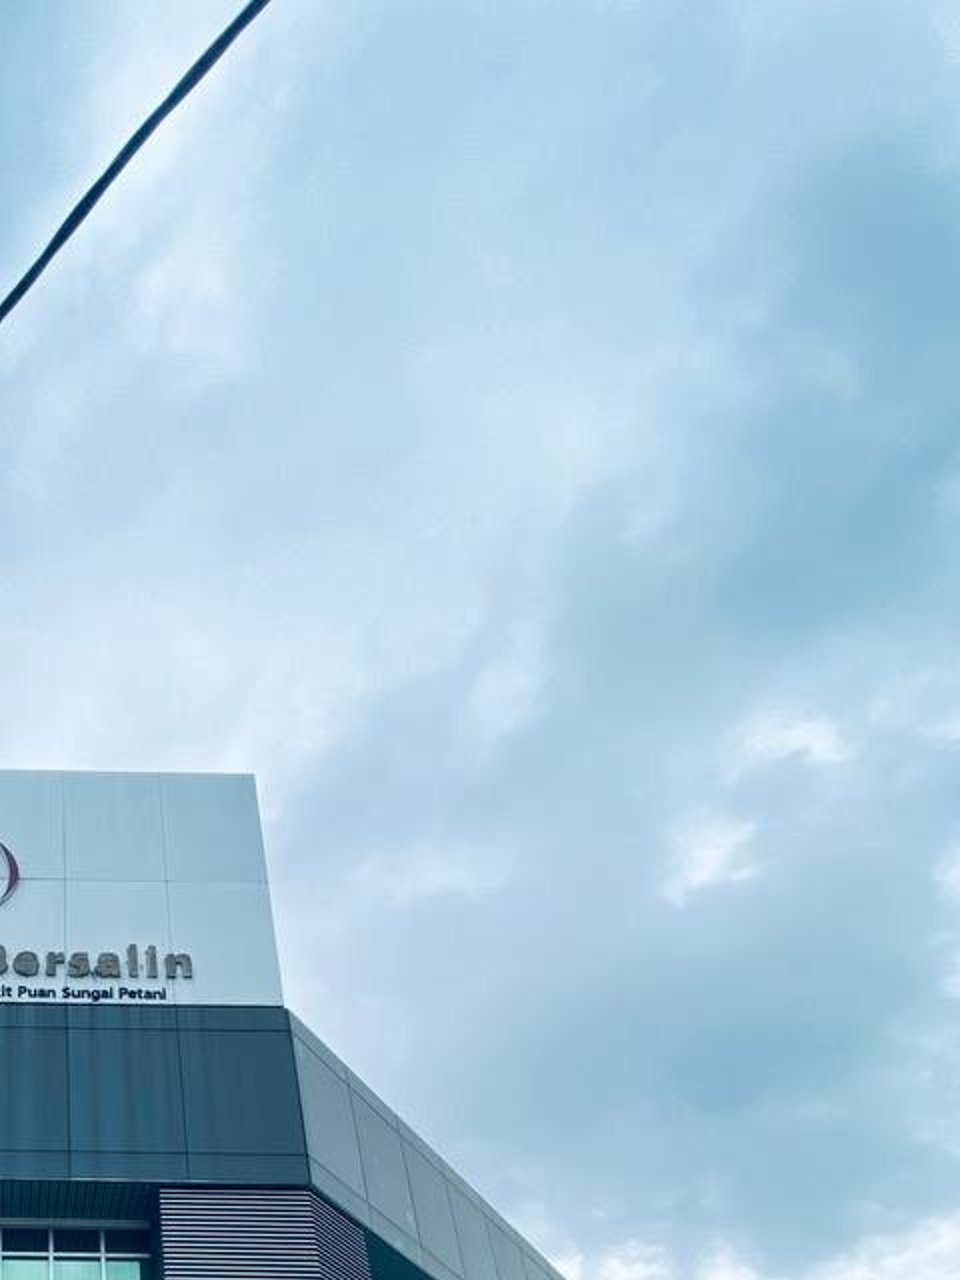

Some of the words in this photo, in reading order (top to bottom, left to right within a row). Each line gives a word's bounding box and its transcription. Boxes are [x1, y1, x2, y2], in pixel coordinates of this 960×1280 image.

[17, 985, 57, 998] Puan
[61, 986, 114, 1002] Sungai
[117, 986, 167, 1000] Petani
